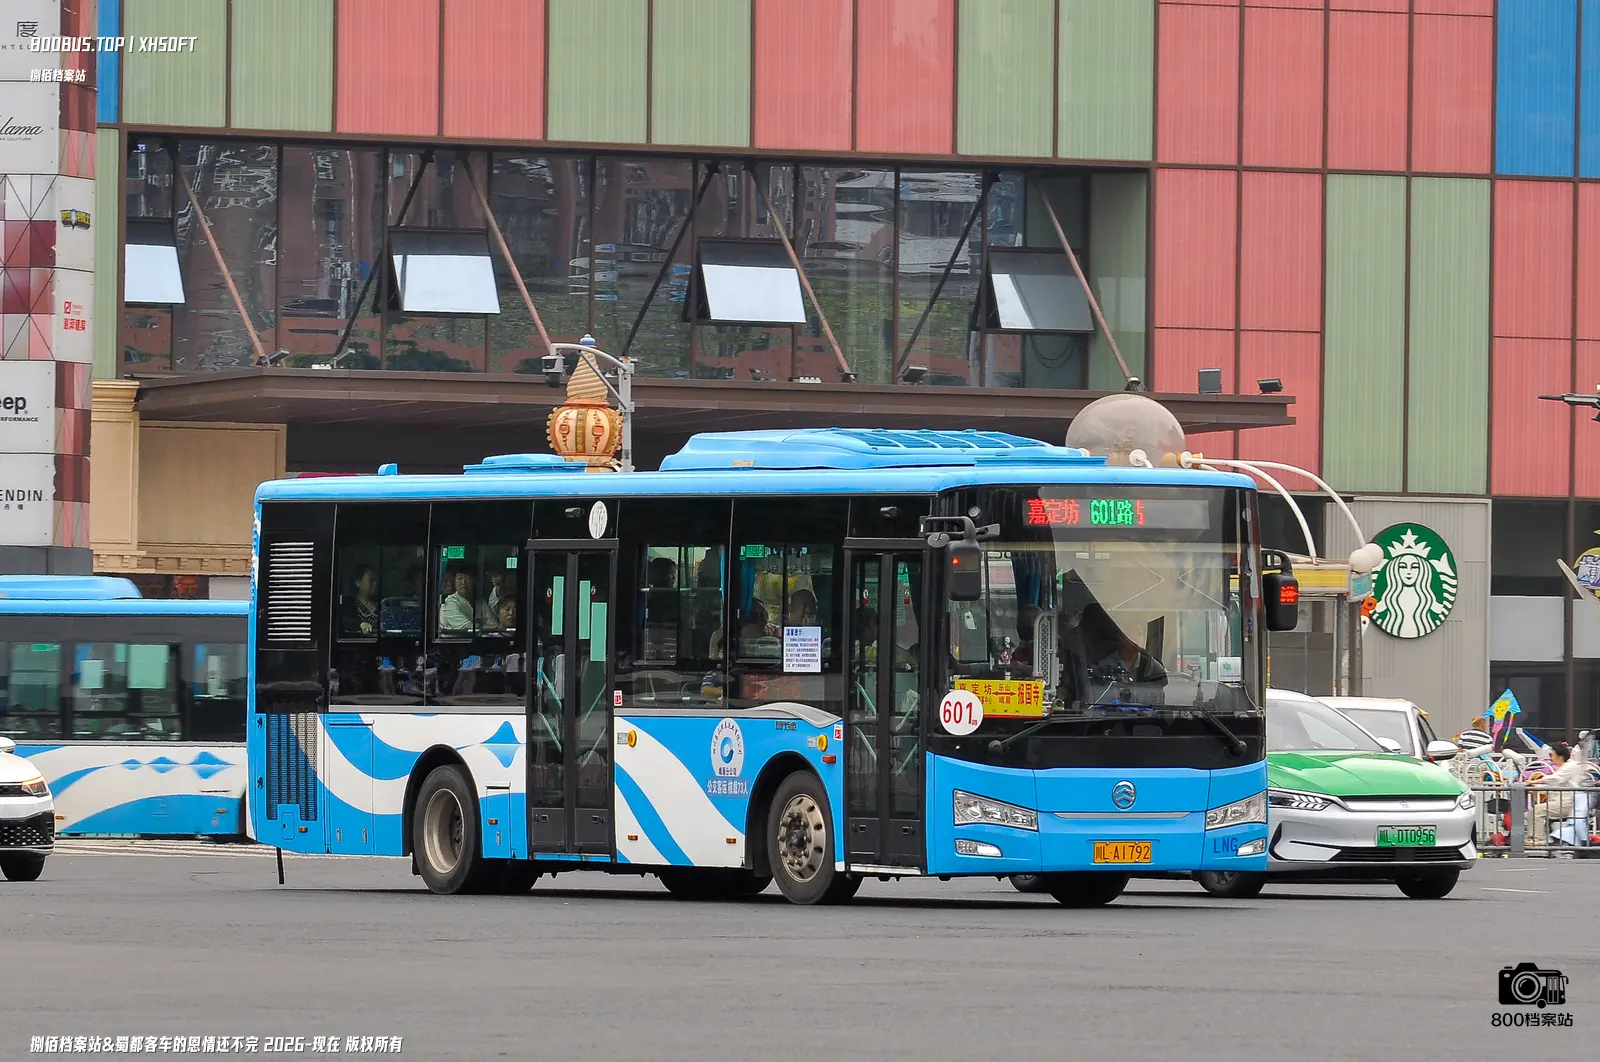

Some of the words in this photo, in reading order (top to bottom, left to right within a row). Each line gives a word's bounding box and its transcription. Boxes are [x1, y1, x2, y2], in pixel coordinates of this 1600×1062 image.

[0, 396, 26, 414] ep
[1028, 499, 1080, 524] 嘉定坊
[1090, 499, 1134, 525] 601路
[998, 684, 1011, 692] 乐山
[1017, 682, 1039, 705] 报国寺
[707, 779, 727, 794] 公交客运
[1213, 837, 1238, 854] LNG
